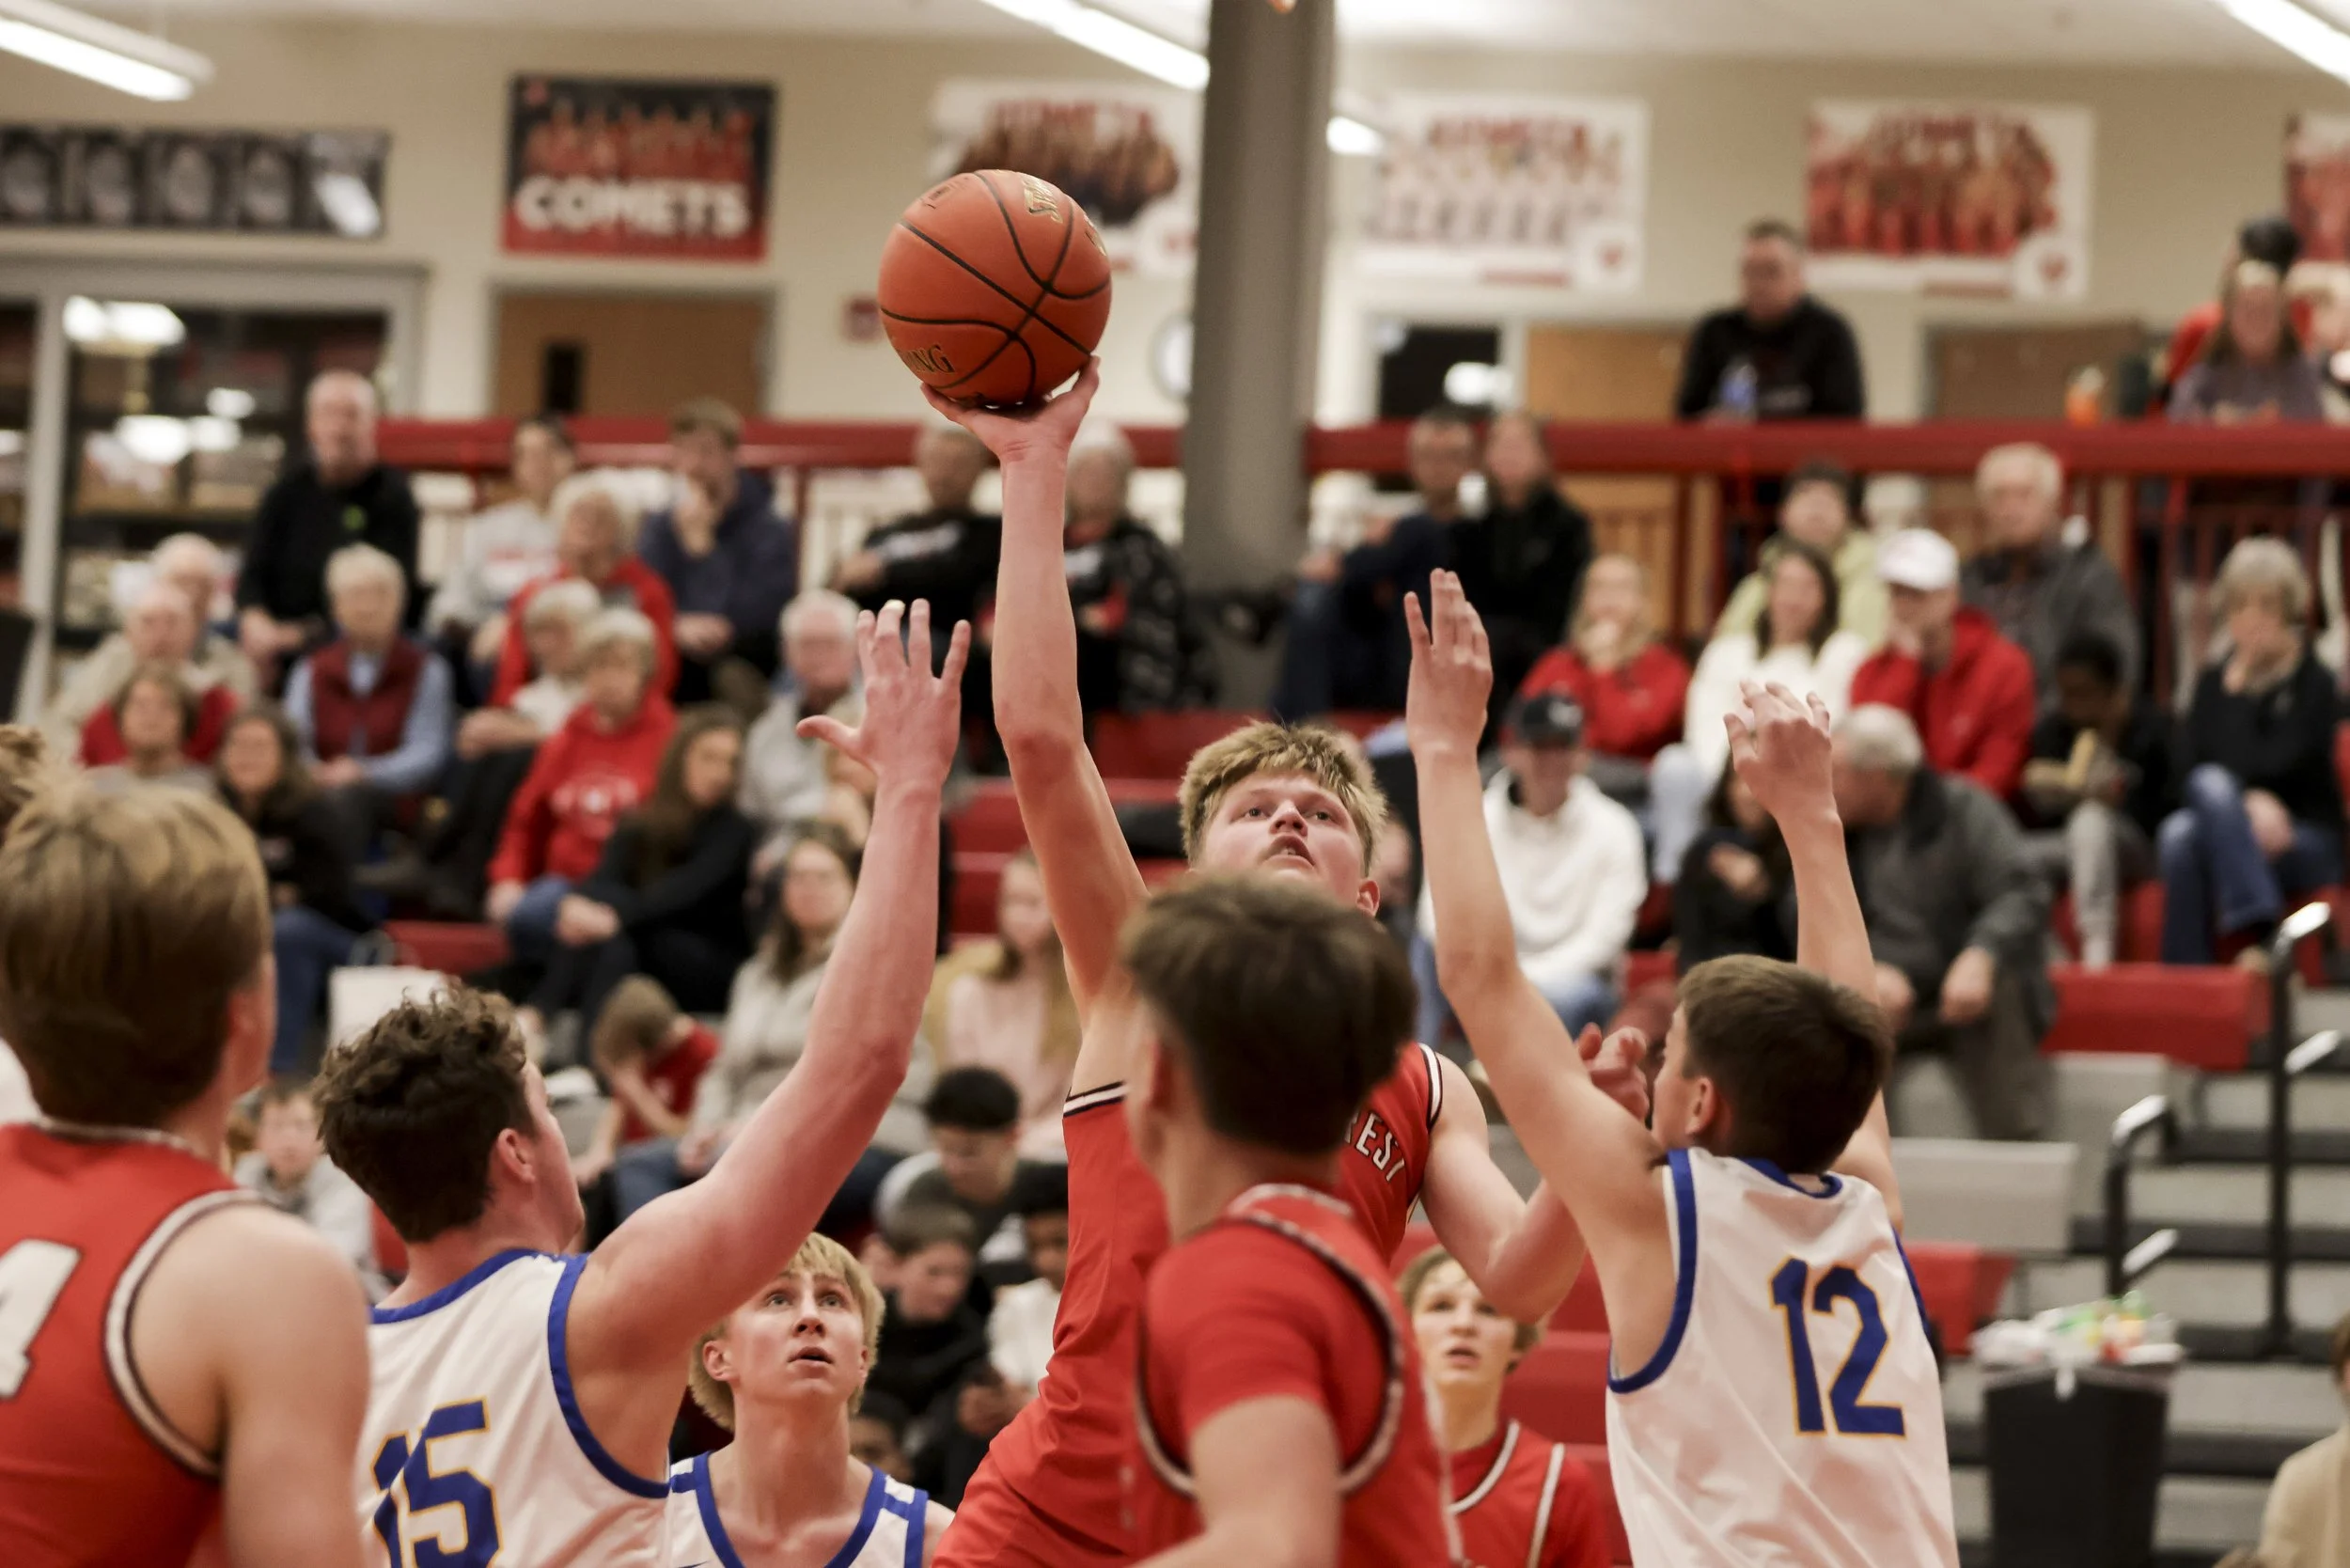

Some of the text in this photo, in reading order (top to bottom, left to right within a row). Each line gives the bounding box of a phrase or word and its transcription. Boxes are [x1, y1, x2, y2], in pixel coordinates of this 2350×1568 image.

[514, 174, 750, 240] COMETS
[1767, 1252, 1908, 1440] 12
[370, 1395, 505, 1568] 15
